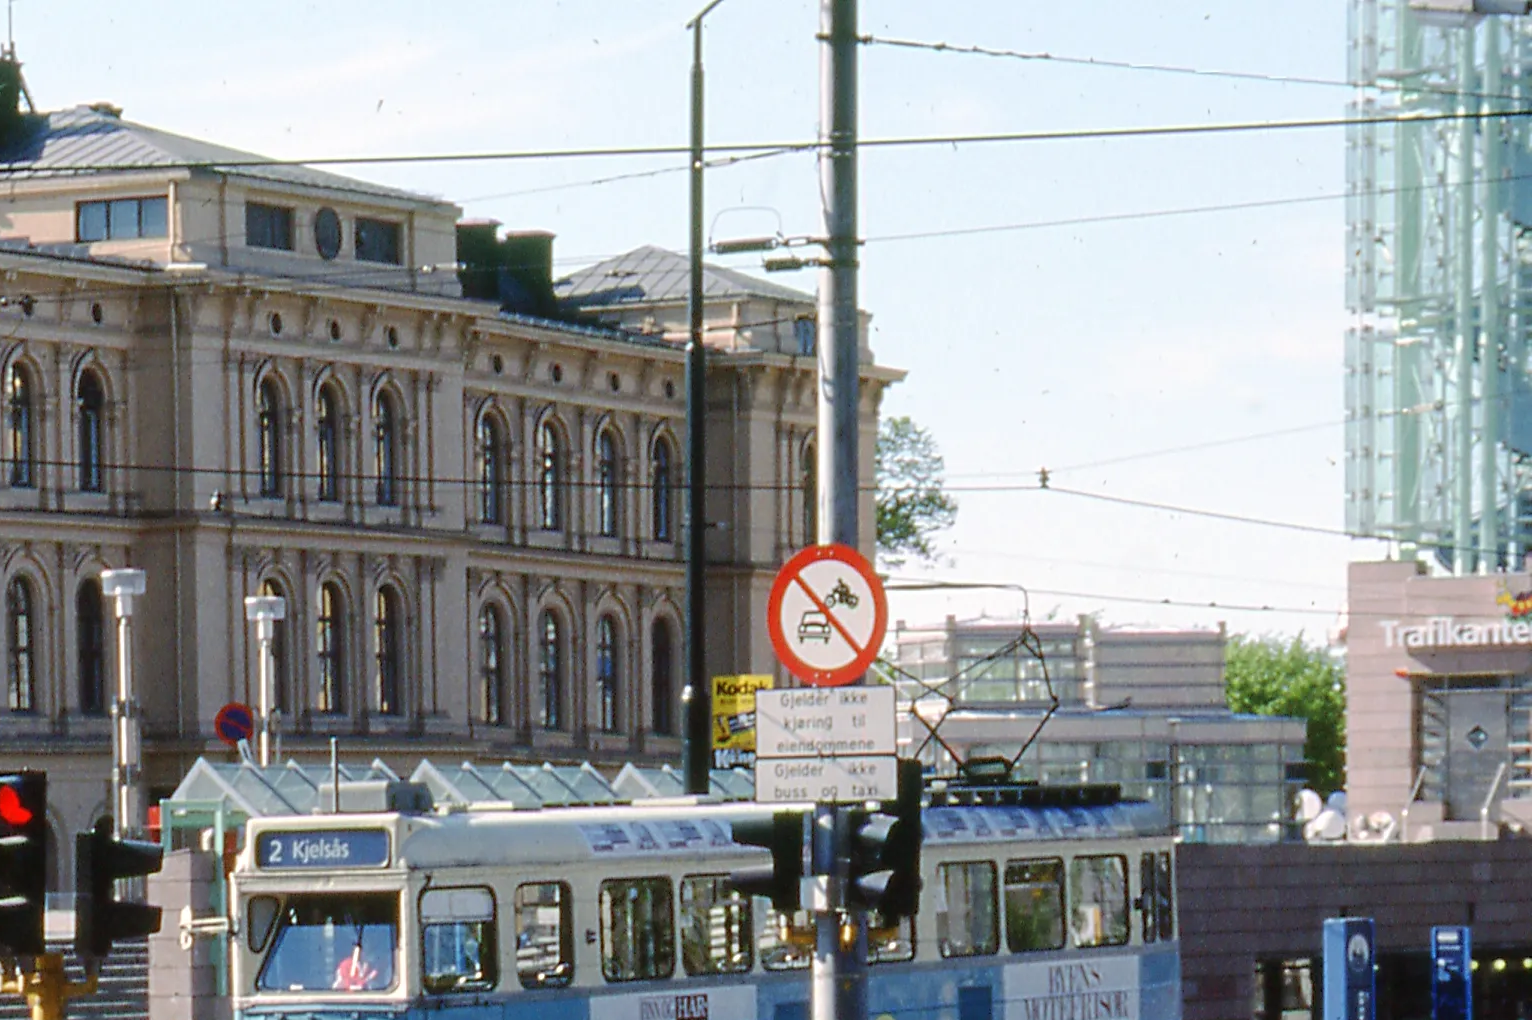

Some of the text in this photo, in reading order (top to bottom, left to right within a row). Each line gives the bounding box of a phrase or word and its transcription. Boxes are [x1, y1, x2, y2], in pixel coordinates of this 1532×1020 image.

[781, 691, 867, 708] Gjelder ikke
[852, 715, 865, 728] til
[775, 764, 877, 779] Gjelder ikke
[775, 784, 877, 802] buss og taxi
[269, 838, 349, 863] 2 Kjelsås
